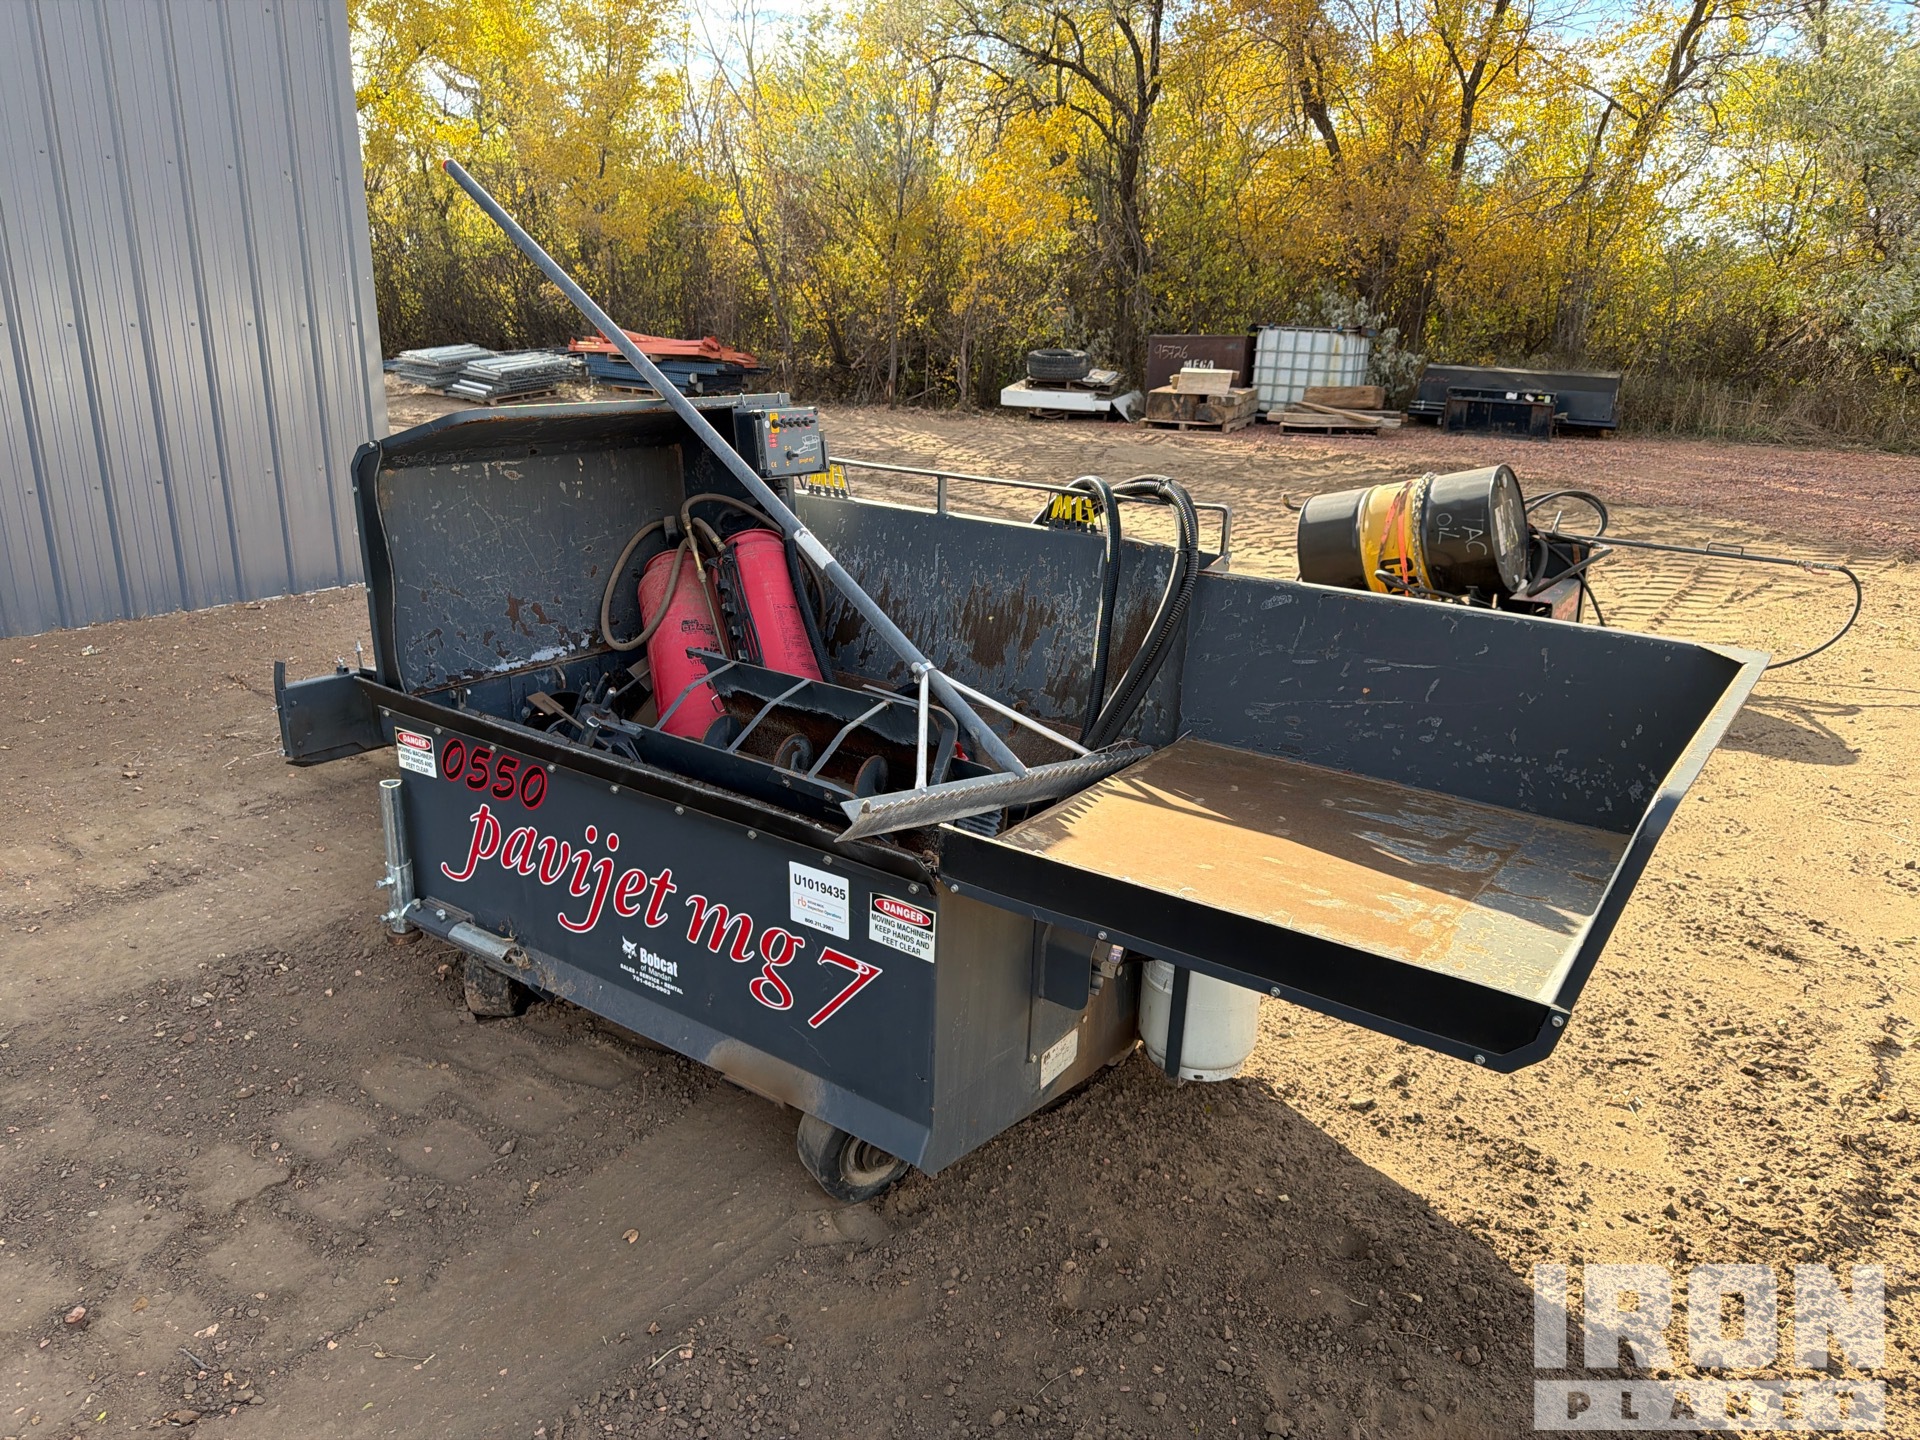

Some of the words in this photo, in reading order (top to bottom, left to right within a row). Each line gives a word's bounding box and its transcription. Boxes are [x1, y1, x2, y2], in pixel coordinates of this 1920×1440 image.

[1154, 344, 1189, 360] 95726
[1051, 493, 1095, 524] MG
[1461, 509, 1488, 556] TAC
[402, 734, 427, 748] DANGER
[406, 762, 416, 770] FEET
[416, 765, 429, 773] CLEAR
[411, 757, 424, 766] HANDS
[425, 761, 433, 769] AND
[413, 750, 434, 761] MACHINERY
[441, 737, 548, 810] 0550
[793, 873, 846, 901] U1019435
[440, 803, 677, 934] pavijet
[685, 894, 805, 1011] mg
[807, 946, 883, 1029] 7
[883, 901, 923, 924] DANGER
[871, 913, 896, 928] MOVING
[896, 922, 934, 942] MACHINERY
[874, 924, 891, 935] KEEP
[892, 930, 915, 945] HANDS
[915, 939, 930, 950] AND
[882, 935, 898, 947] FEET
[899, 942, 921, 956] CLEAR
[639, 947, 678, 977] Bobcat
[620, 963, 636, 974] SALES
[639, 971, 660, 985] SERVICE
[663, 982, 684, 995] RENTAL
